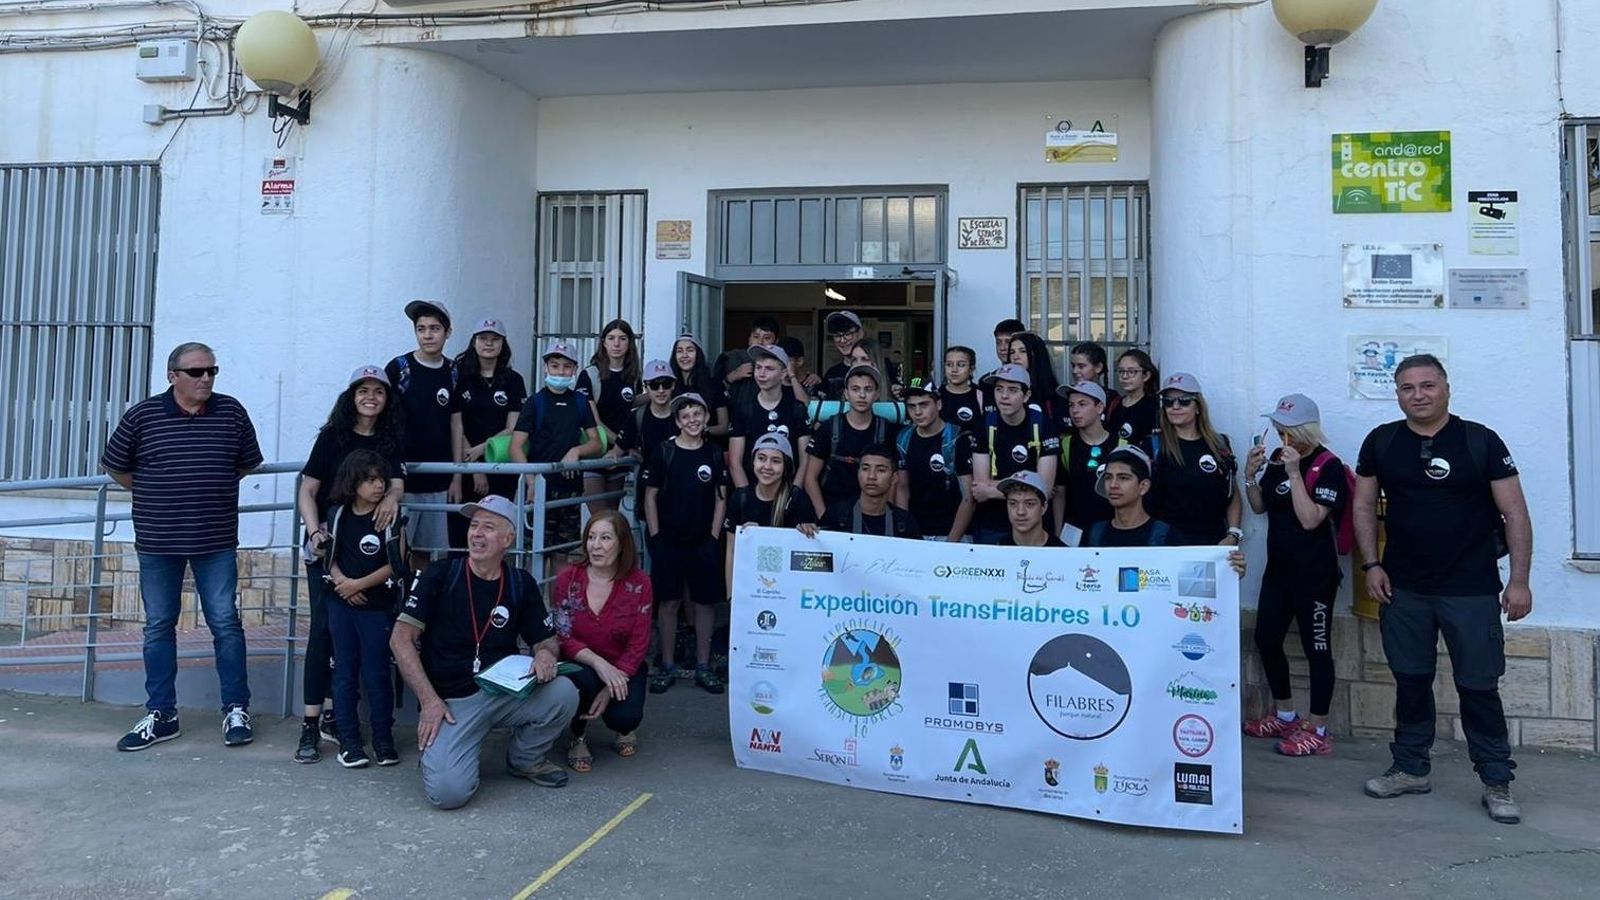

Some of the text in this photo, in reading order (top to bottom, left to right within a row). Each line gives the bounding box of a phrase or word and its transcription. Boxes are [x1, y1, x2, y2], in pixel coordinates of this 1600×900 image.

[1374, 142, 1443, 157] and@red
[263, 182, 293, 190] Alarma
[952, 566, 1006, 578] GREENXXI
[800, 588, 1141, 628] Expedición TransFilabres 1.0
[1314, 601, 1328, 651] ACTIVE
[1046, 694, 1116, 713] FILABRES
[924, 717, 1004, 733] PROMOBYS
[749, 742, 782, 753] NANTA
[935, 774, 1011, 788] Junta de Andalucía
[1176, 772, 1210, 785] LUMAI
